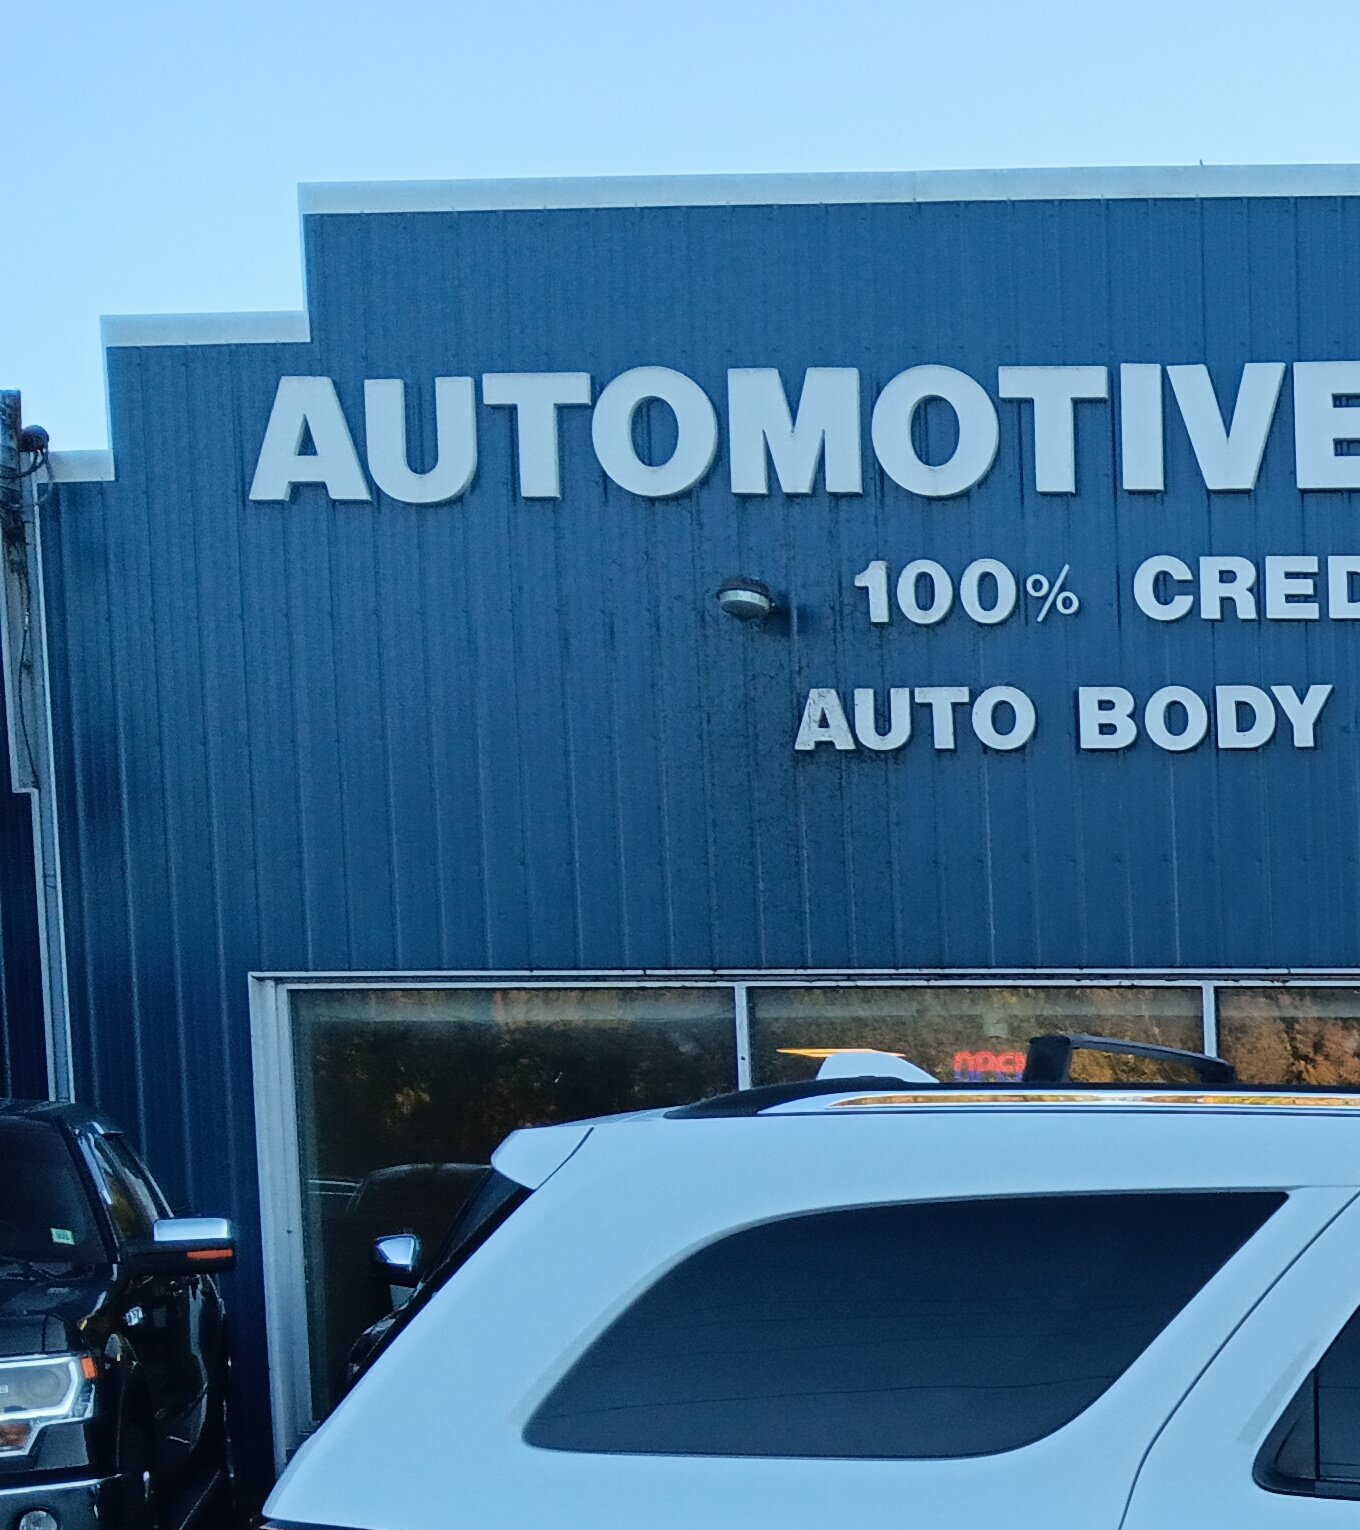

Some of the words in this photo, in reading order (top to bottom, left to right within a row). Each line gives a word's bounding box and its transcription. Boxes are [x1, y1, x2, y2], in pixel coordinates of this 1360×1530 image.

[854, 557, 1080, 626] 100%
[793, 685, 1036, 752] AUTO
[1078, 684, 1333, 752] BODY
